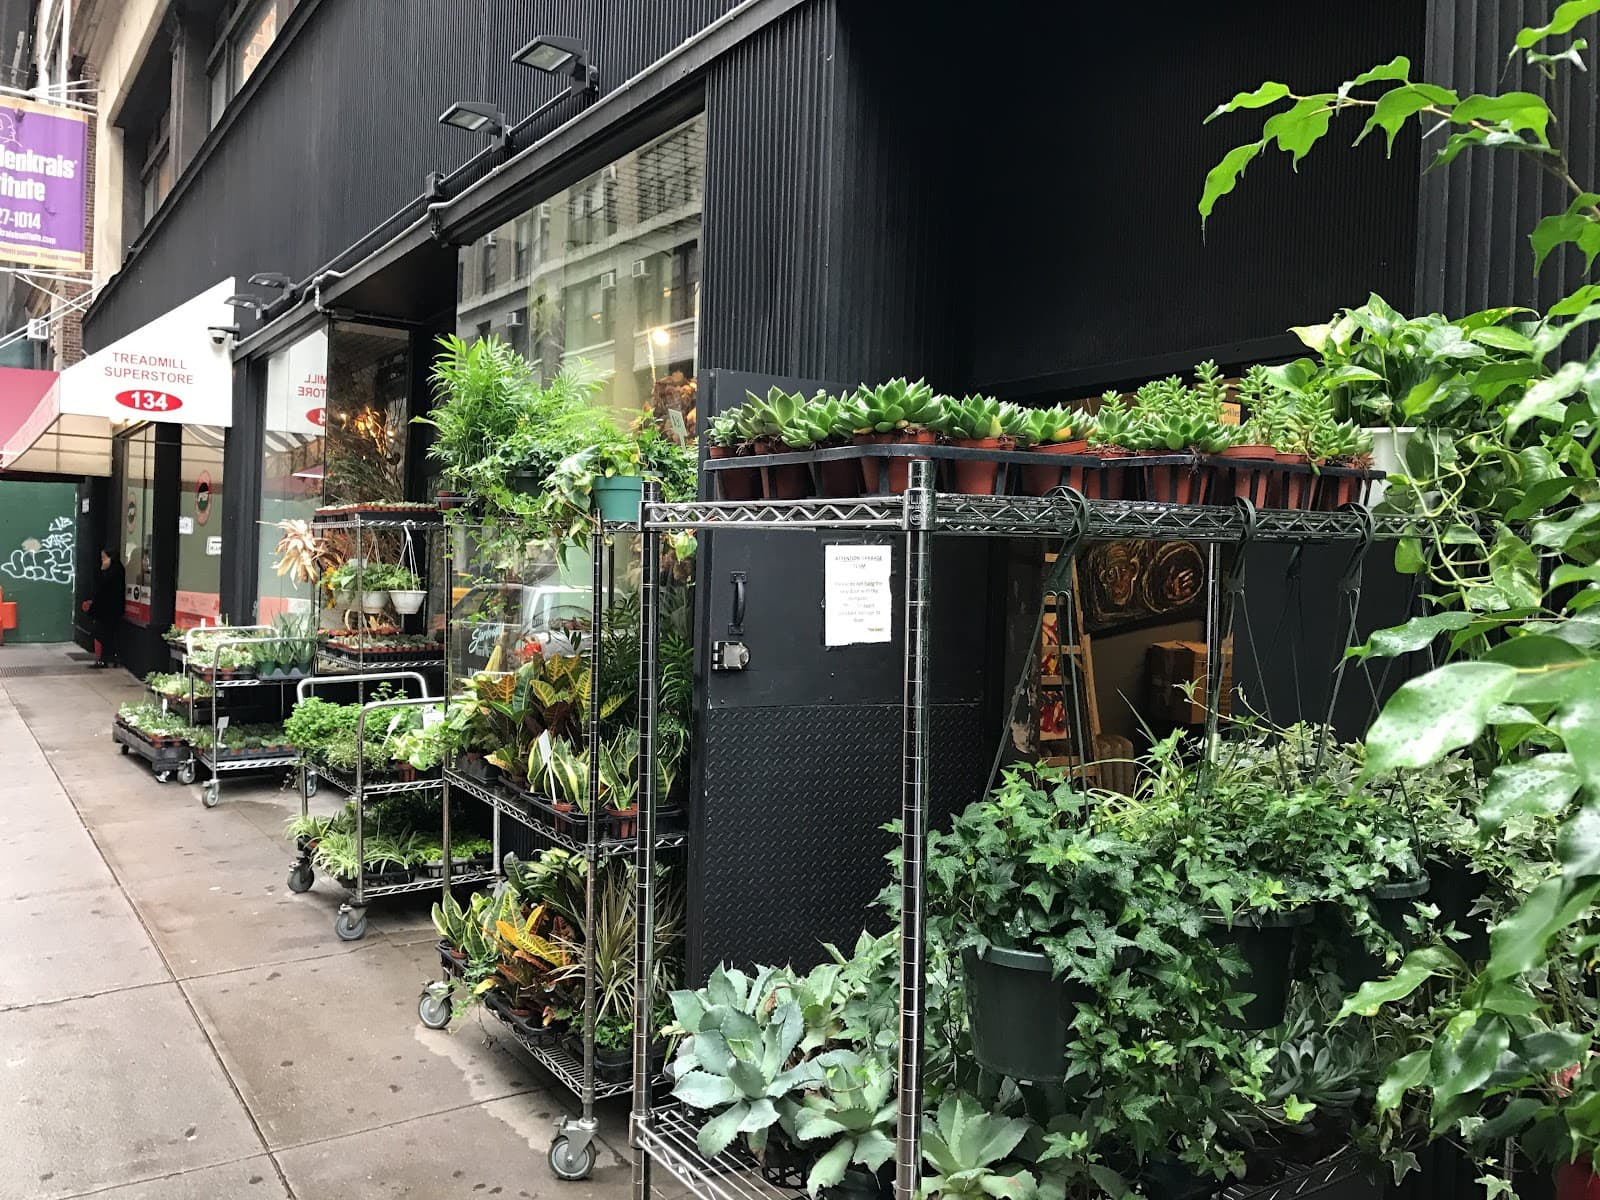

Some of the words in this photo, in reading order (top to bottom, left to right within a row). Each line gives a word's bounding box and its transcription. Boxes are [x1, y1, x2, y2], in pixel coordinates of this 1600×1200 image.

[0, 172, 46, 202] itute
[112, 352, 187, 369] TREADMILL
[104, 366, 194, 385] SUPERSTORE
[131, 391, 169, 411] 134
